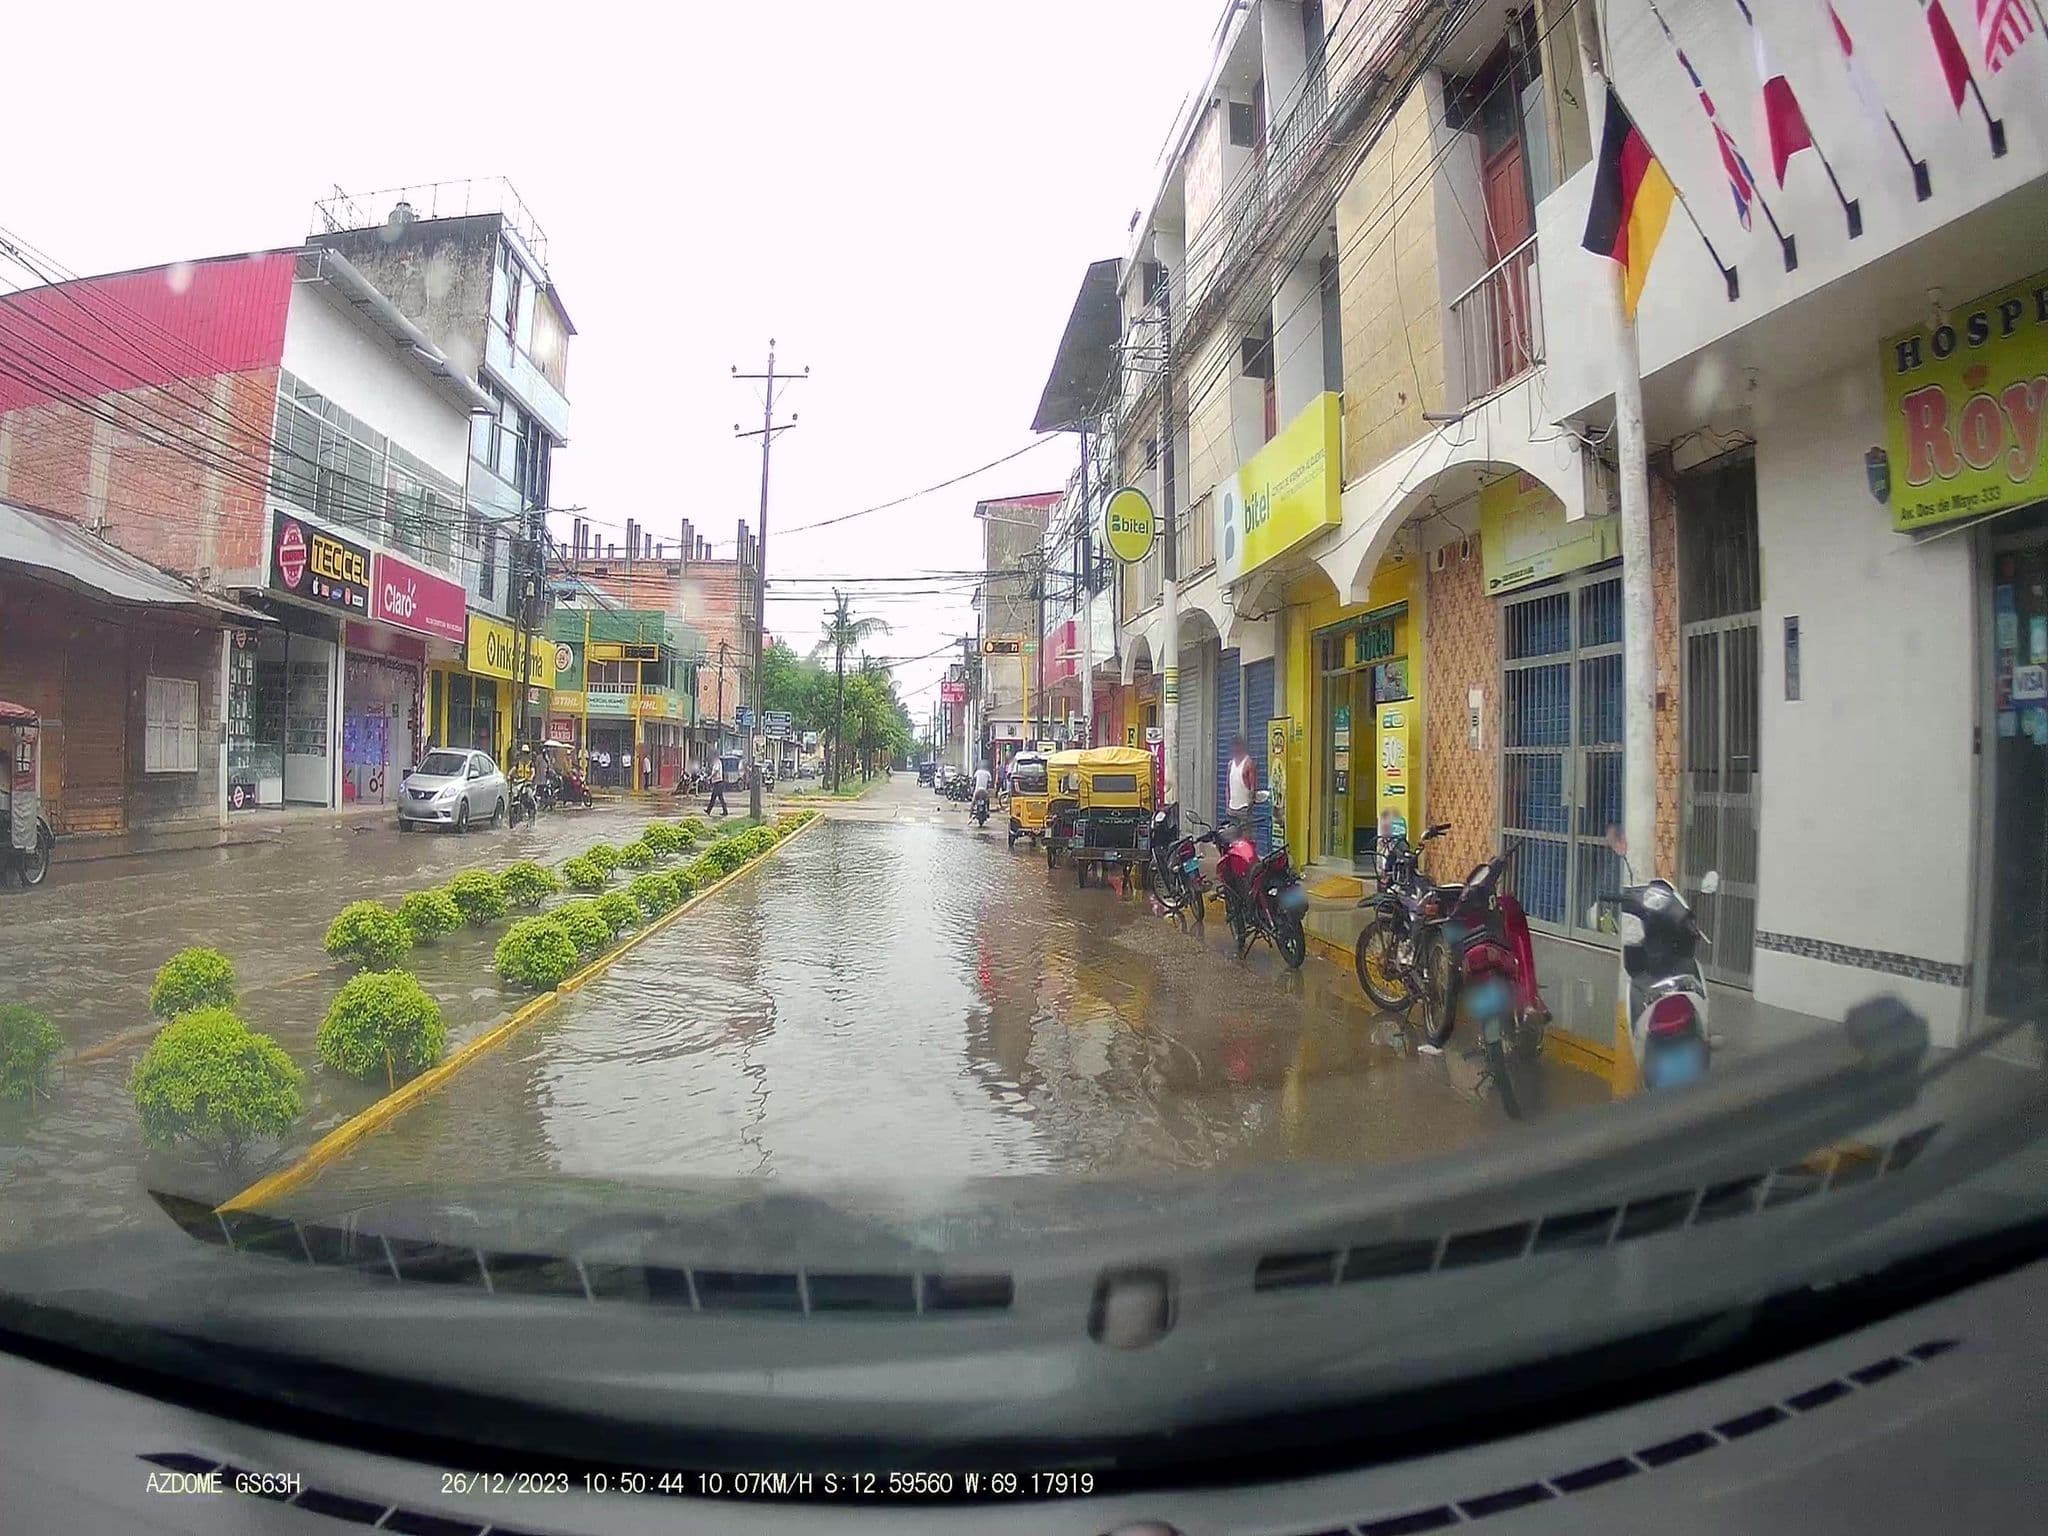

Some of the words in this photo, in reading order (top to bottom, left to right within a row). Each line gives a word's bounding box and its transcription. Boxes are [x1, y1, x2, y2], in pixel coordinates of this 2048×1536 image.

[1245, 482, 1270, 534] bitel
[1916, 503, 1935, 517] Dos
[1938, 499, 1950, 512] de
[1951, 495, 1978, 511] Mayo
[1122, 517, 1149, 534] bitel
[313, 536, 369, 587] TECCEL
[384, 582, 413, 618] Claro
[551, 696, 579, 706] STIHL
